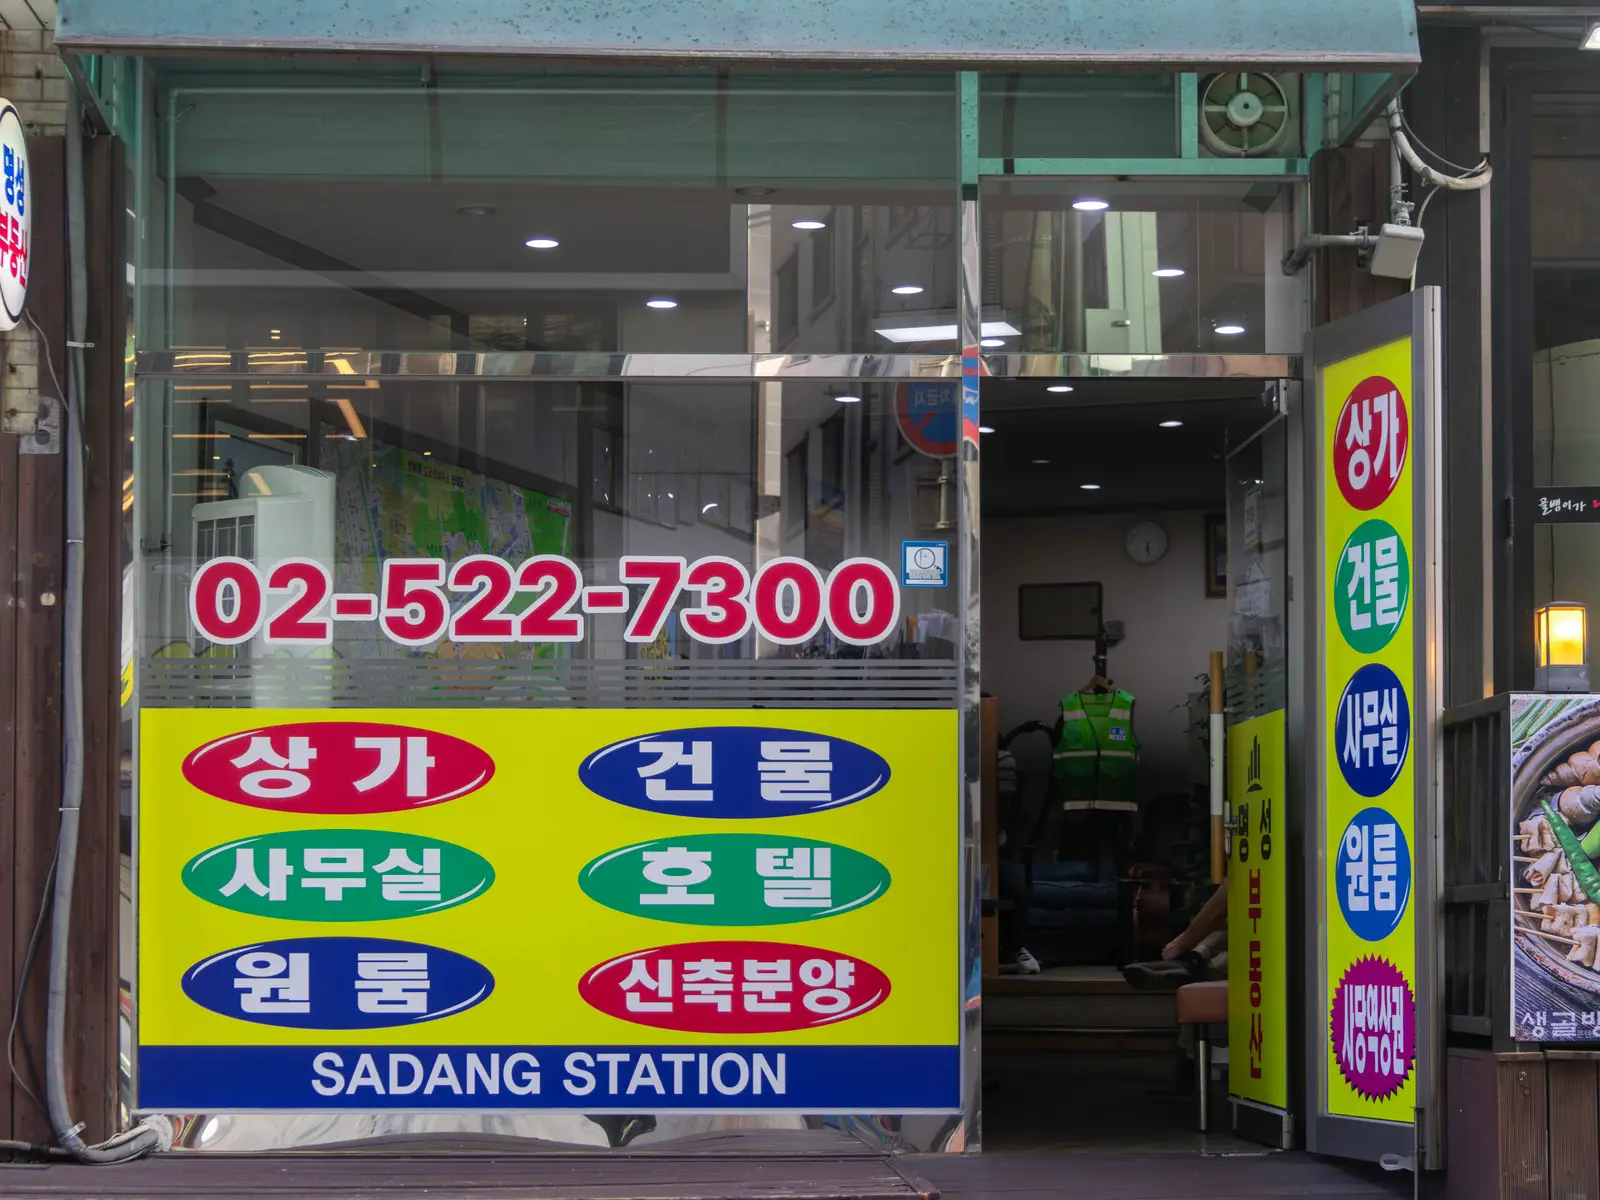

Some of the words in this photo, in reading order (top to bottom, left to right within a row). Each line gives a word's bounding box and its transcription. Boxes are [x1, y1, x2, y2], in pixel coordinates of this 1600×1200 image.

[3, 143, 25, 216] 명성
[1345, 390, 1399, 490] 상가
[1538, 496, 1587, 516] 골뱅이가
[189, 553, 901, 646] 02-522-7300
[1347, 535, 1399, 631] 건물
[1343, 688, 1398, 768] 사무실
[218, 848, 442, 901] 사무실
[1346, 823, 1397, 911] 원룸
[619, 959, 855, 1014] 신축분양
[1341, 983, 1404, 1077] 사당역상권
[311, 1051, 541, 1096] SADANG
[562, 1051, 786, 1096] STATION
